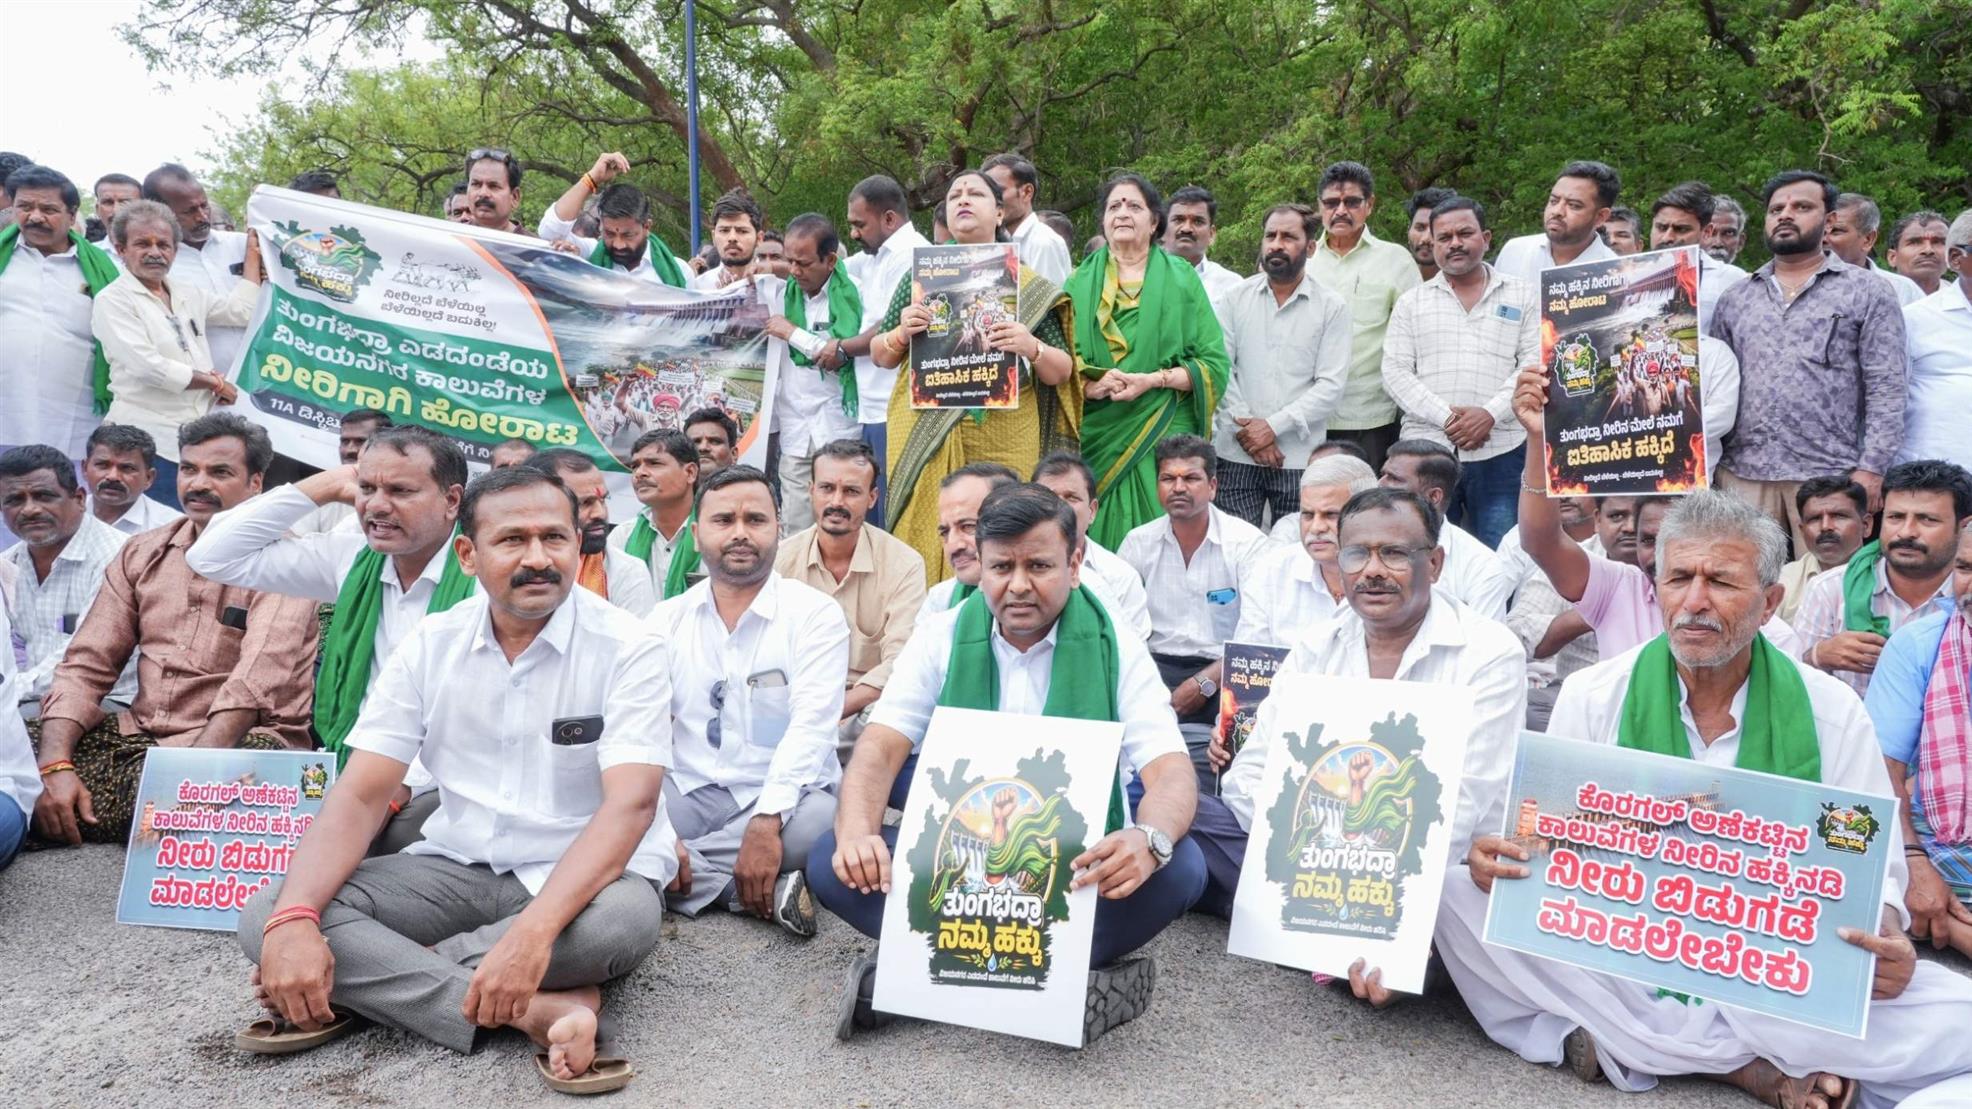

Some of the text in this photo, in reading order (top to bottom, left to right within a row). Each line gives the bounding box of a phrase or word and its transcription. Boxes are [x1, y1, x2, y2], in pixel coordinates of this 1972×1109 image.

[277, 298, 549, 379] ತುಂಗಭದ್ರಾ ಎಡದಂಡೆಯ
[272, 324, 547, 405] ವಿಜಯನಗರ ಕಾಲುವೆಗಳ
[260, 354, 578, 446] ನೀರಿಗಾಗಿ ಹೋರಾಟ
[270, 398, 294, 415] 11A
[1559, 425, 1602, 442] ತುಂಗಭದ್ರಾ
[1603, 419, 1629, 437] ನೀರಿನ
[1630, 415, 1655, 432] ಮೇಲೆ
[1567, 430, 1675, 466] ಐತಿಹಾಸಿಕ ಹಕ್ಕಿದೆ
[178, 779, 240, 802] ಕೊರಗಲ್
[241, 783, 299, 813] ಅಣೆಕಟ್ಟಿನ
[153, 808, 224, 829] ಕಾಲುವೆಗಳ
[226, 811, 269, 832] ನೀರಿನ
[1577, 782, 1810, 859] ಕೊರಗಲ್ ಅಣೆಕಟ್ಟಿನ
[157, 837, 297, 873] ನೀರು ಬಿಡುಗ
[1300, 842, 1396, 880] ತುಂಗಭದ್ರಾ
[1537, 814, 1845, 899] ಕಾಲುವೆಗಳ ನೀರಿನ ಹಕ್ಕಿನಡಿ
[943, 886, 1043, 927] ತುಂಗಭದ್ರಾ
[1292, 870, 1395, 917] ನಮ್ಮ ಹಕ್ಕು
[1547, 849, 1819, 944] ನೀರು ಬಿಡುಗಡೆ
[938, 917, 1043, 967] ನಮ್ಮ ಹಕ್ಕು
[1537, 898, 1811, 995] ಮಾಡಲೇಬೇಕು
